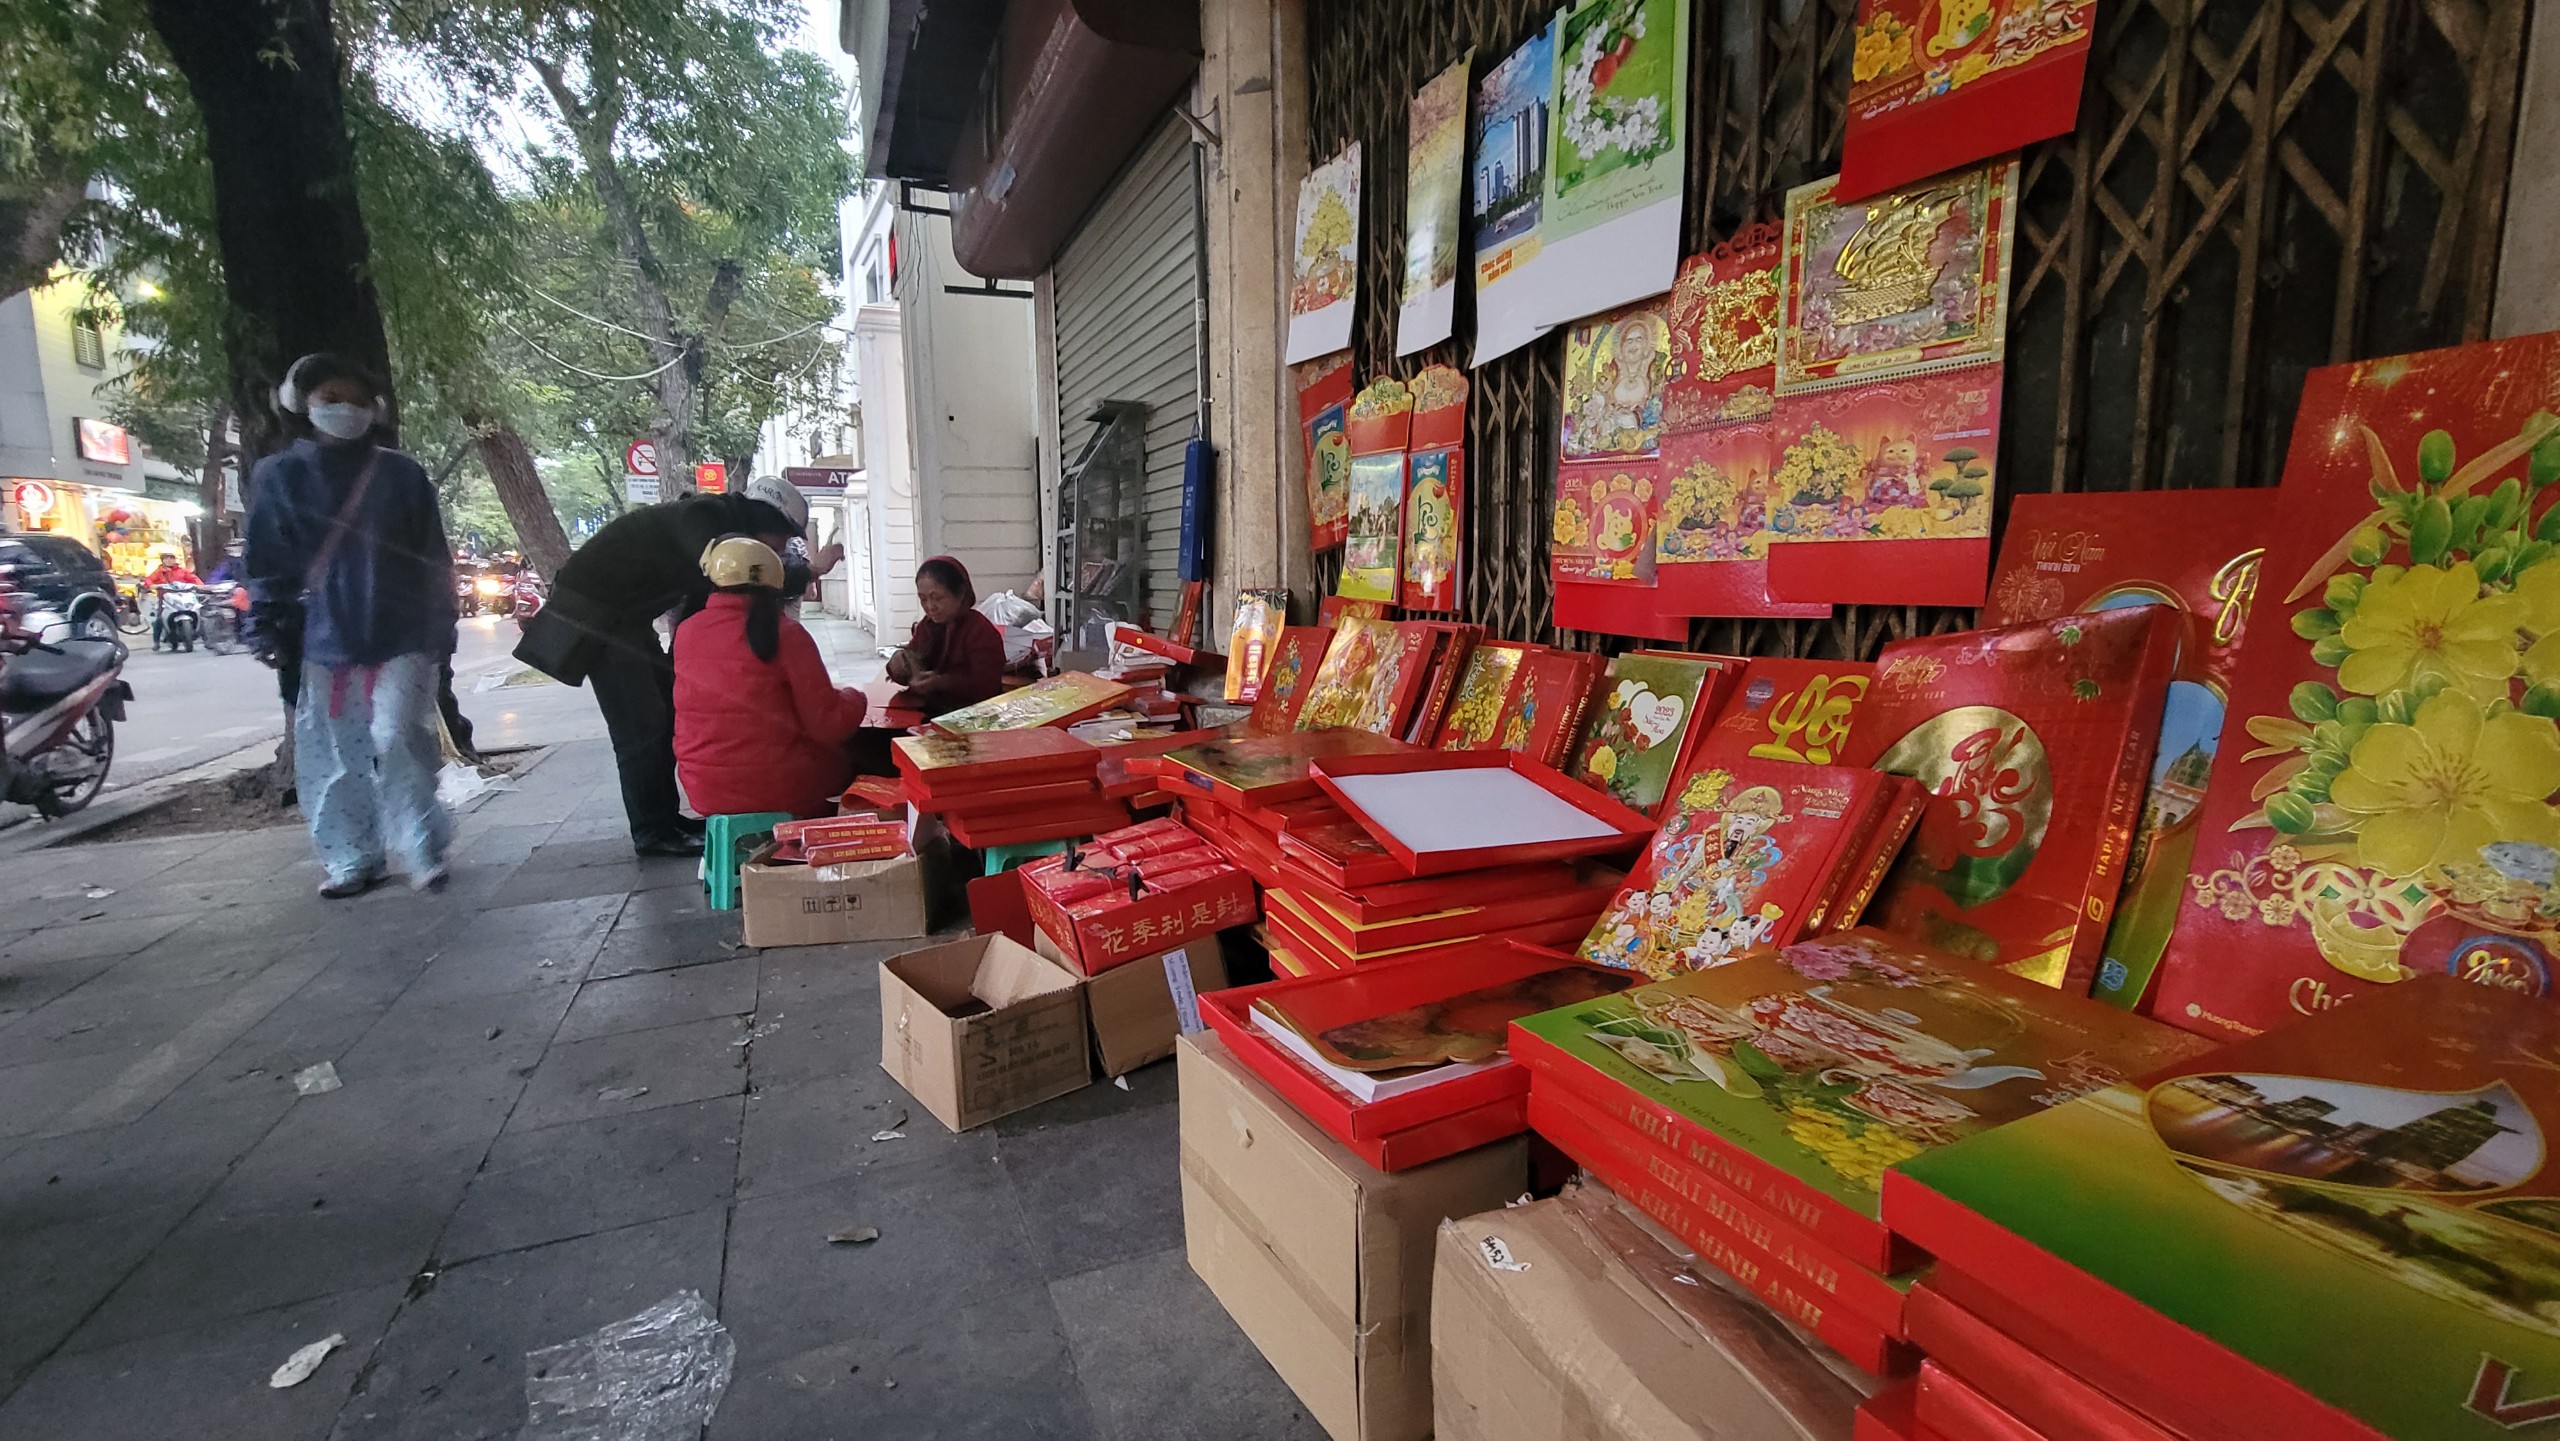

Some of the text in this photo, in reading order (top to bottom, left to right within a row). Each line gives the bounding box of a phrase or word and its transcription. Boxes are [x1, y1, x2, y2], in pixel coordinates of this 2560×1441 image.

[828, 471, 851, 484] AT
[2096, 822, 2118, 877] HAPPY
[2111, 779, 2130, 815] NEW
[2122, 729, 2142, 770] YEAR
[1101, 892, 1239, 957] 花季利是封
[2288, 977, 2354, 1016] Ch
[1687, 1140, 1756, 1191] MINH
[1759, 1183, 1823, 1230] ANH
[1694, 1226, 1761, 1285] MINH
[1763, 1278, 1824, 1329] ANH
[1704, 1192, 1773, 1253] MINH
[1777, 1242, 1839, 1295] ANH
